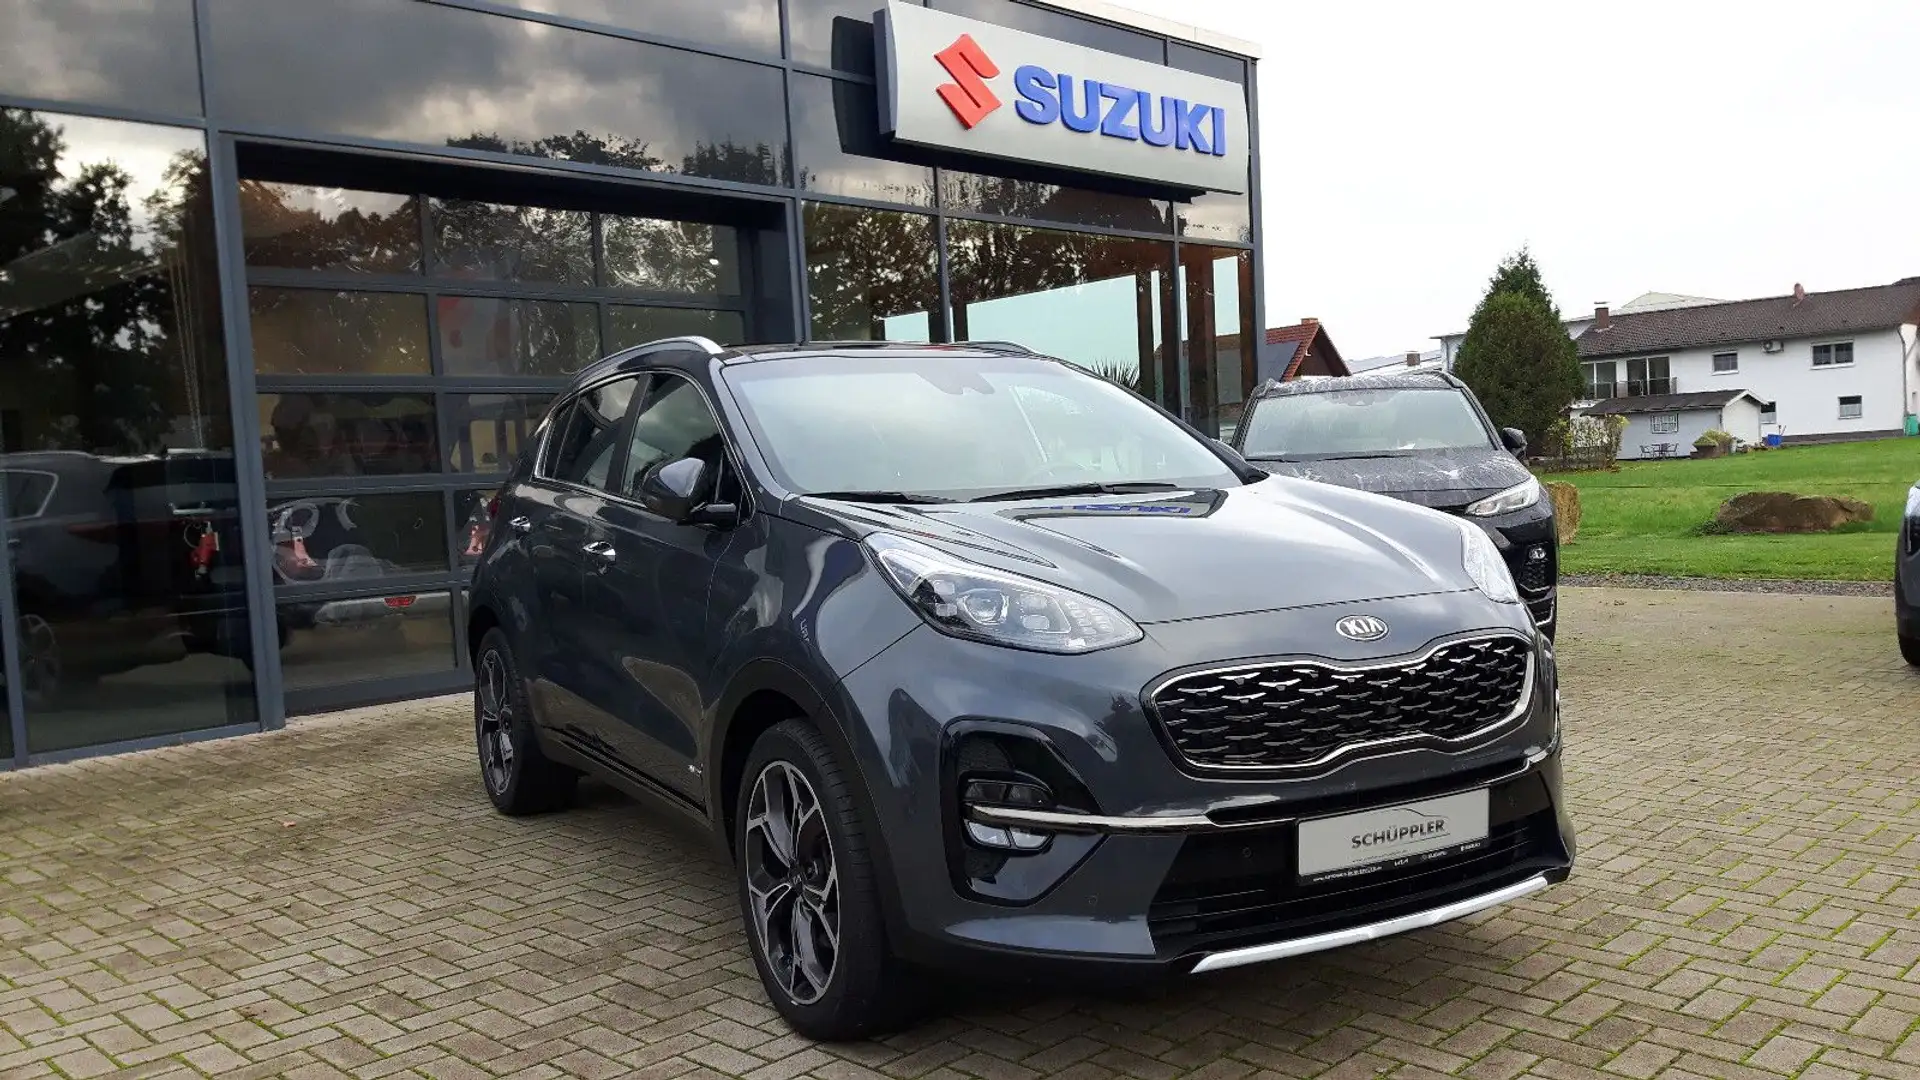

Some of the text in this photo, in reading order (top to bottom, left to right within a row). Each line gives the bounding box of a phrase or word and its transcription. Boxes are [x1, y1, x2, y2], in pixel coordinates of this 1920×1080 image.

[1014, 64, 1226, 156] SUZUKI
[1342, 617, 1383, 635] KIA
[1351, 819, 1445, 848] SCHÜPPLER
